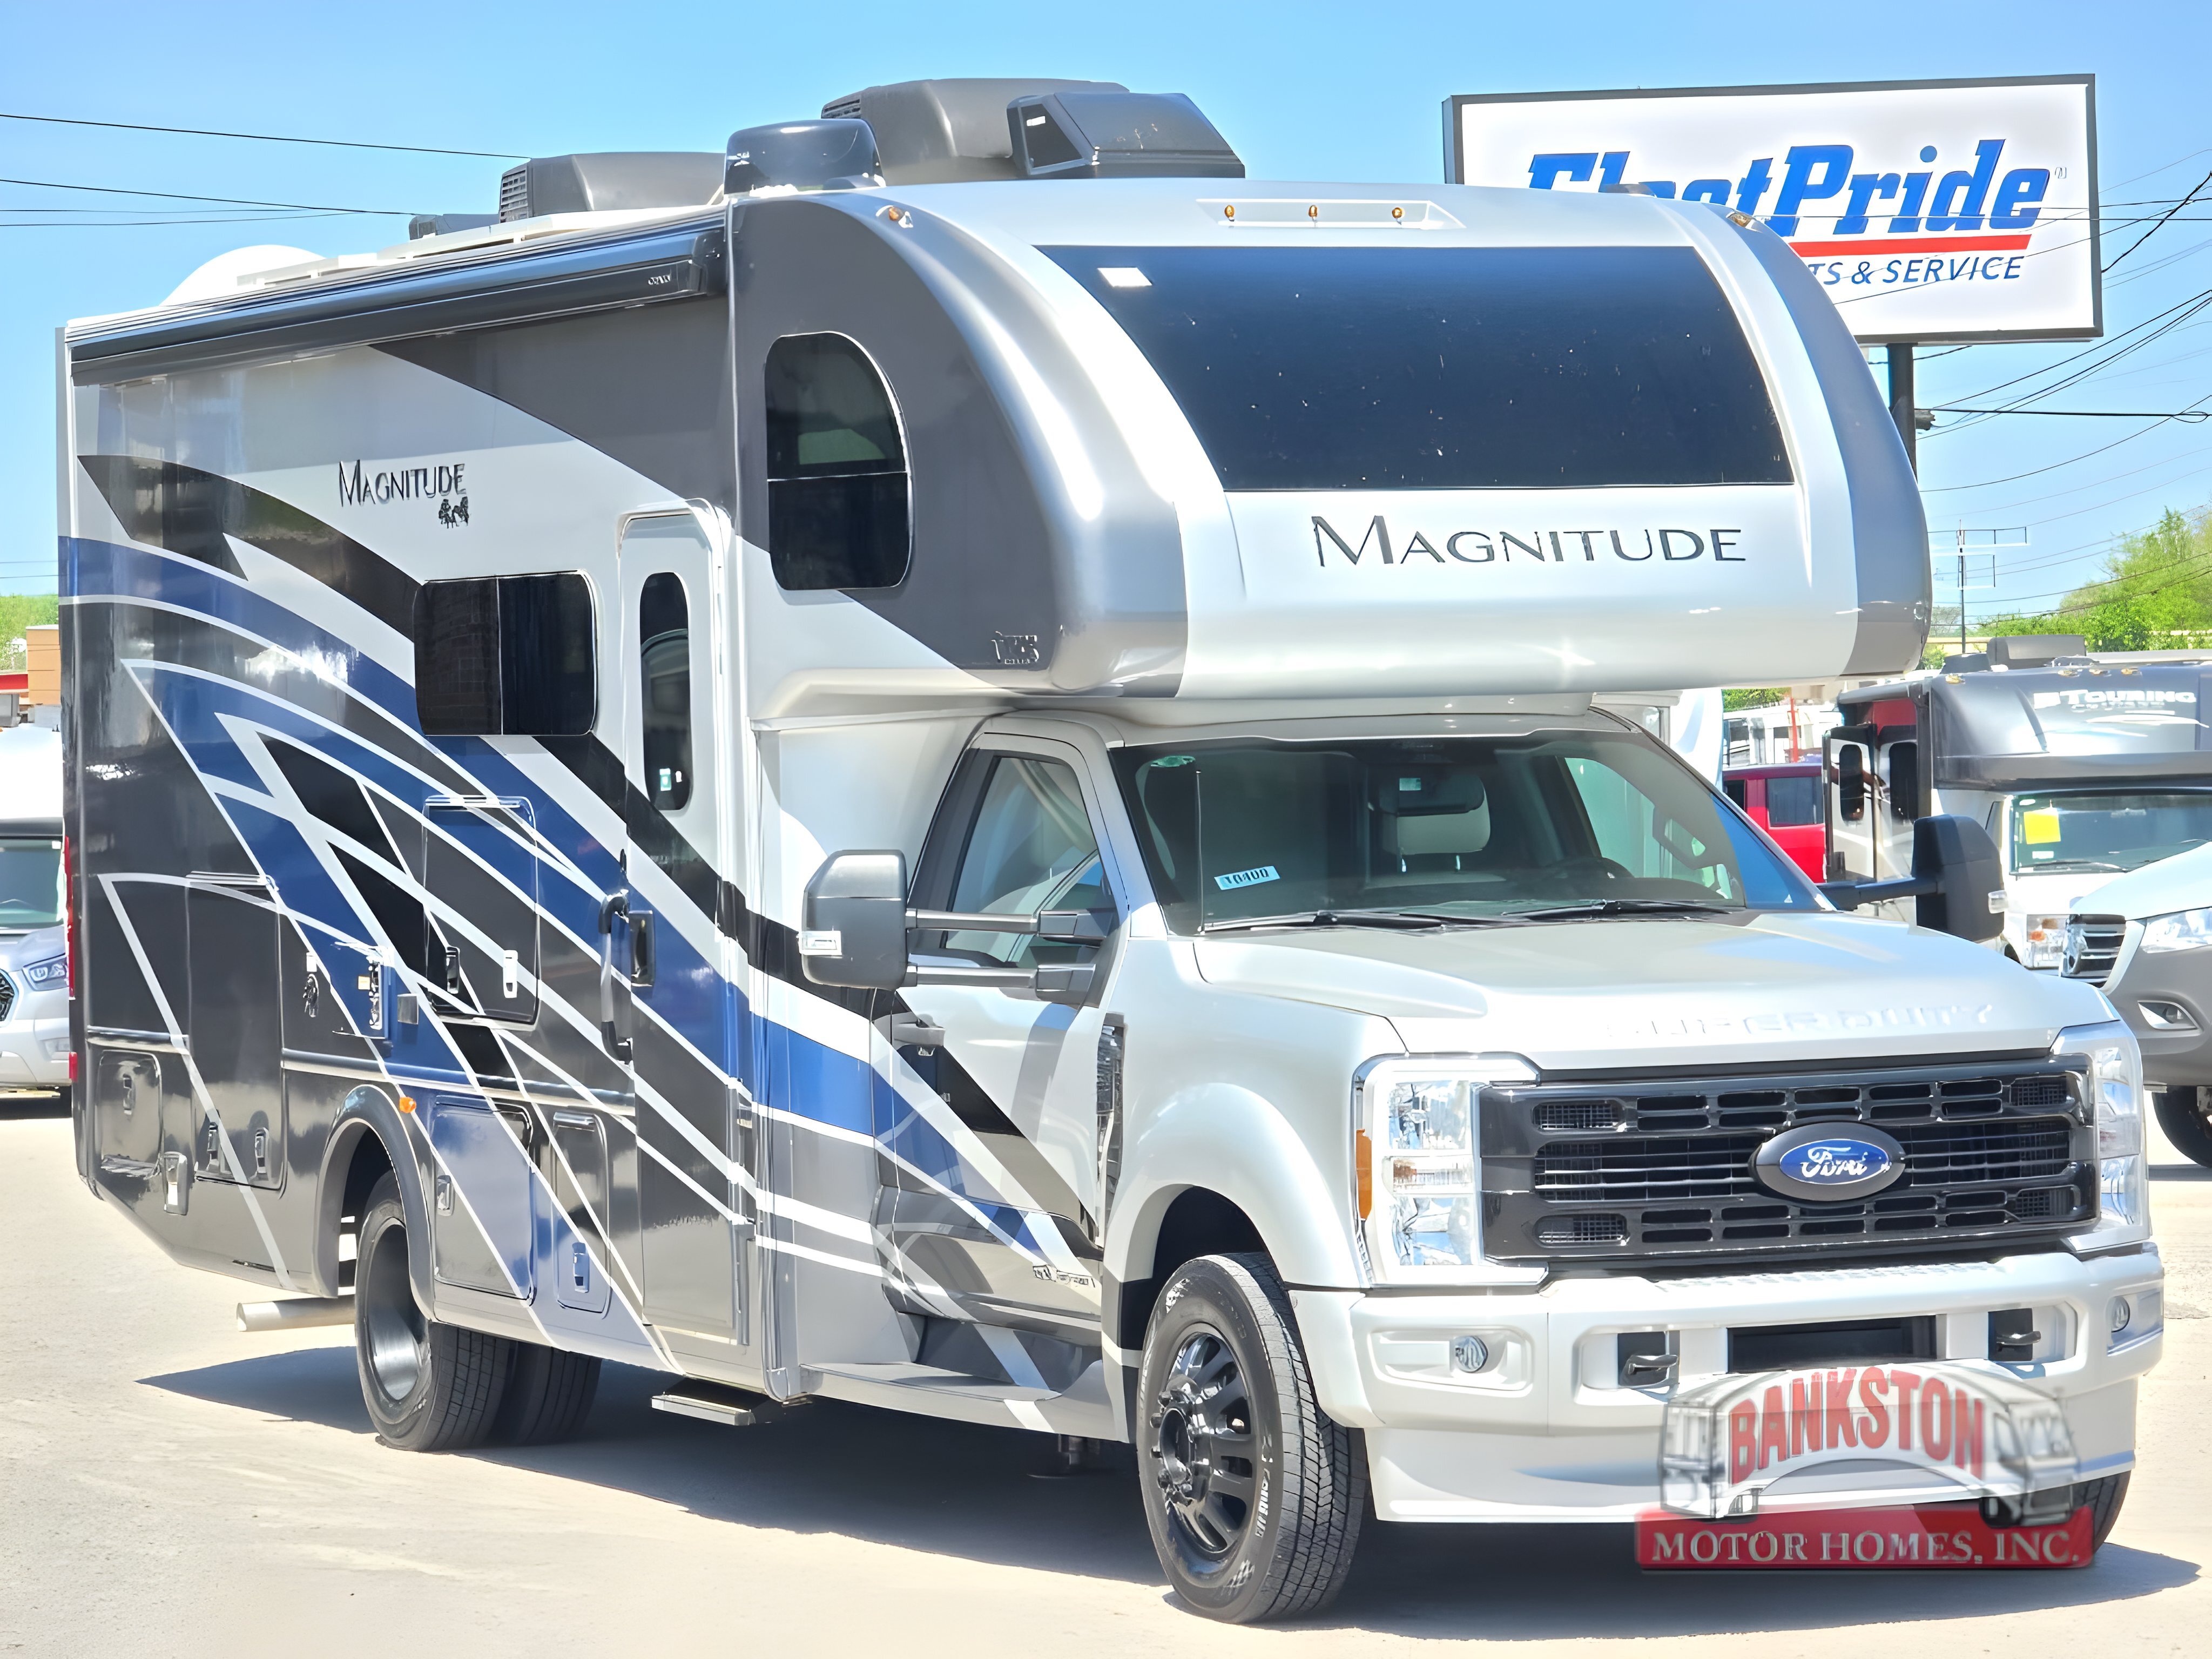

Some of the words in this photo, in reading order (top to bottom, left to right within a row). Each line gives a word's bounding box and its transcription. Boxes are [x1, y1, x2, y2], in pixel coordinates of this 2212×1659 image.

[1851, 261, 1873, 285] &
[1883, 255, 2025, 284] SERVICE
[339, 459, 468, 508] MAGNITUDE
[1311, 515, 1746, 567] MAGNITUDE
[1800, 1146, 1867, 1178] Ford
